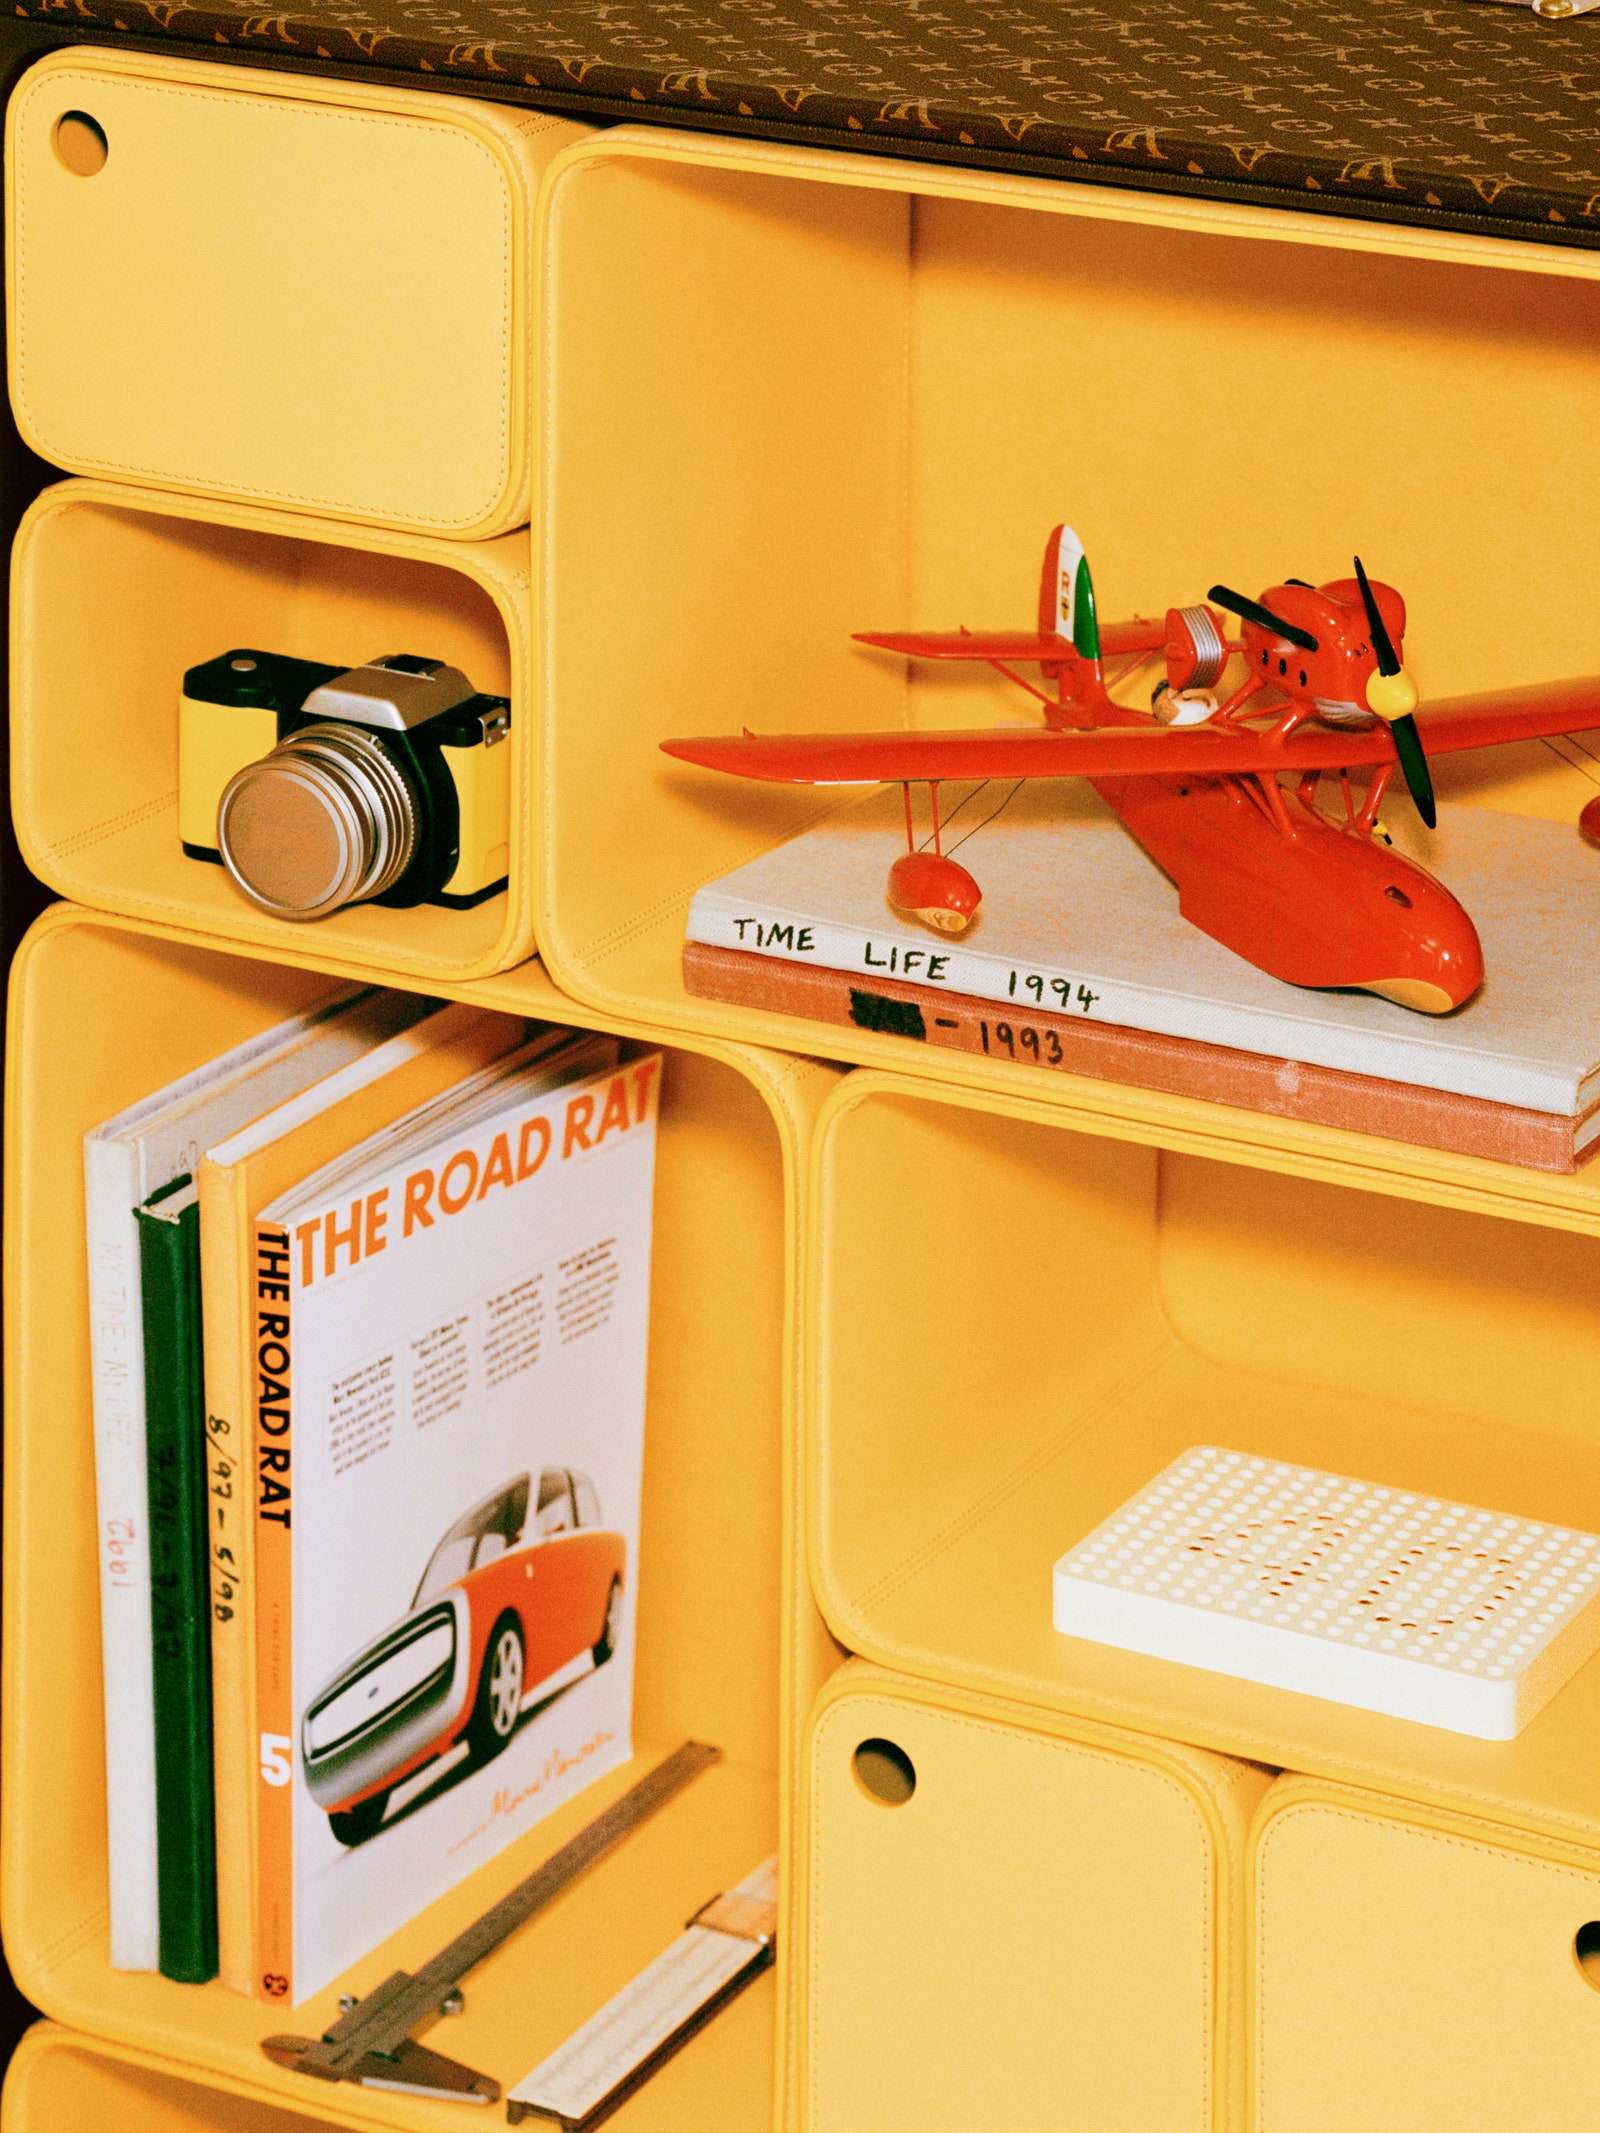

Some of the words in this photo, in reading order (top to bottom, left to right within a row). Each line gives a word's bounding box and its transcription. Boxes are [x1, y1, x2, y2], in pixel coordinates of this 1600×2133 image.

[733, 918, 815, 951] TIME
[864, 942, 950, 980] LIFE
[1008, 971, 1099, 1012] 1994
[980, 1021, 1064, 1065] 1993
[295, 1187, 390, 1288] THE
[403, 1116, 552, 1238] ROAD
[563, 1061, 658, 1158] RAT
[257, 1232, 290, 1302] THE
[258, 1312, 291, 1437] ROAD
[205, 1414, 237, 1500] 8/97
[259, 1446, 291, 1529] RAT
[212, 1544, 240, 1623] 5/98
[260, 1732, 291, 1787] 5
